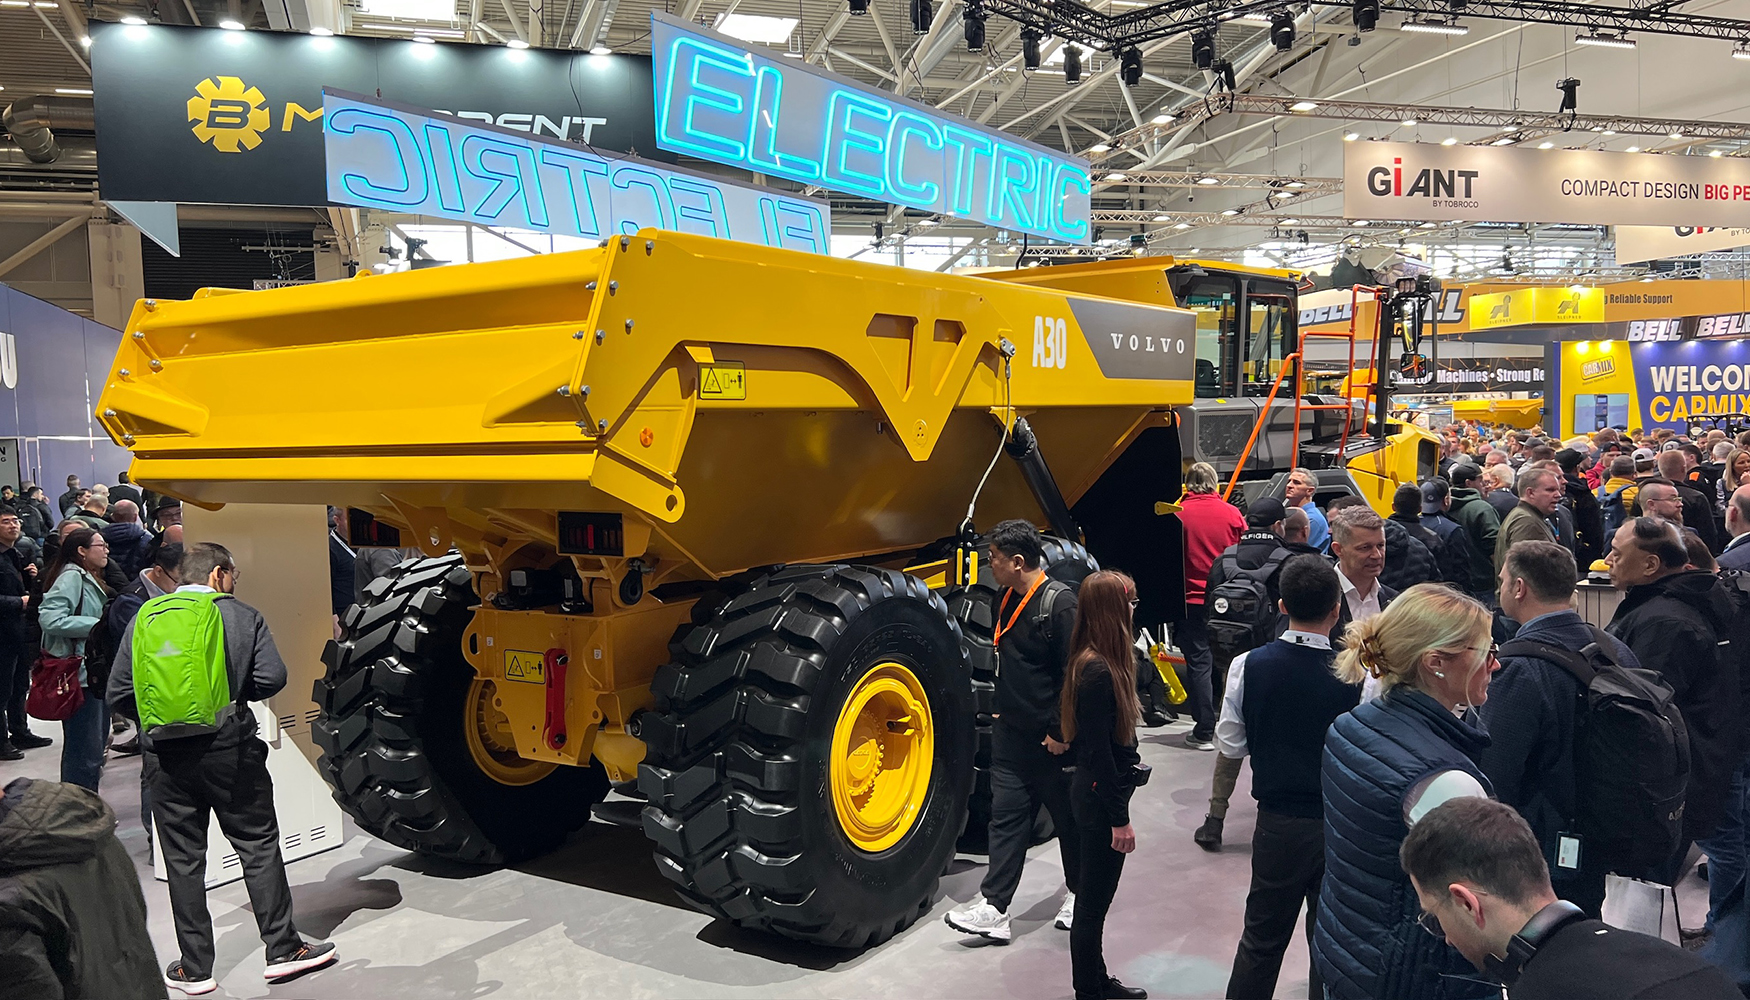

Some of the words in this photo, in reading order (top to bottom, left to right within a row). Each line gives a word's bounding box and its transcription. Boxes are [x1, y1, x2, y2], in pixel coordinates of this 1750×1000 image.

[659, 36, 1091, 241] ELECTRIC
[1561, 179, 1640, 198] COMPACT
[1644, 183, 1699, 199] DESIGN
[1704, 184, 1729, 201] BIG
[1433, 200, 1443, 208] BY
[1444, 200, 1479, 209] TOBROCO
[1609, 294, 1642, 305] Reliable
[1643, 293, 1673, 305] Support
[1626, 319, 1683, 342] BELL
[1032, 315, 1067, 370] A30
[1110, 332, 1185, 355] VOLVO
[1436, 369, 1488, 383] Machines
[1496, 368, 1531, 384] Strong
[1650, 364, 1750, 393] WELCO
